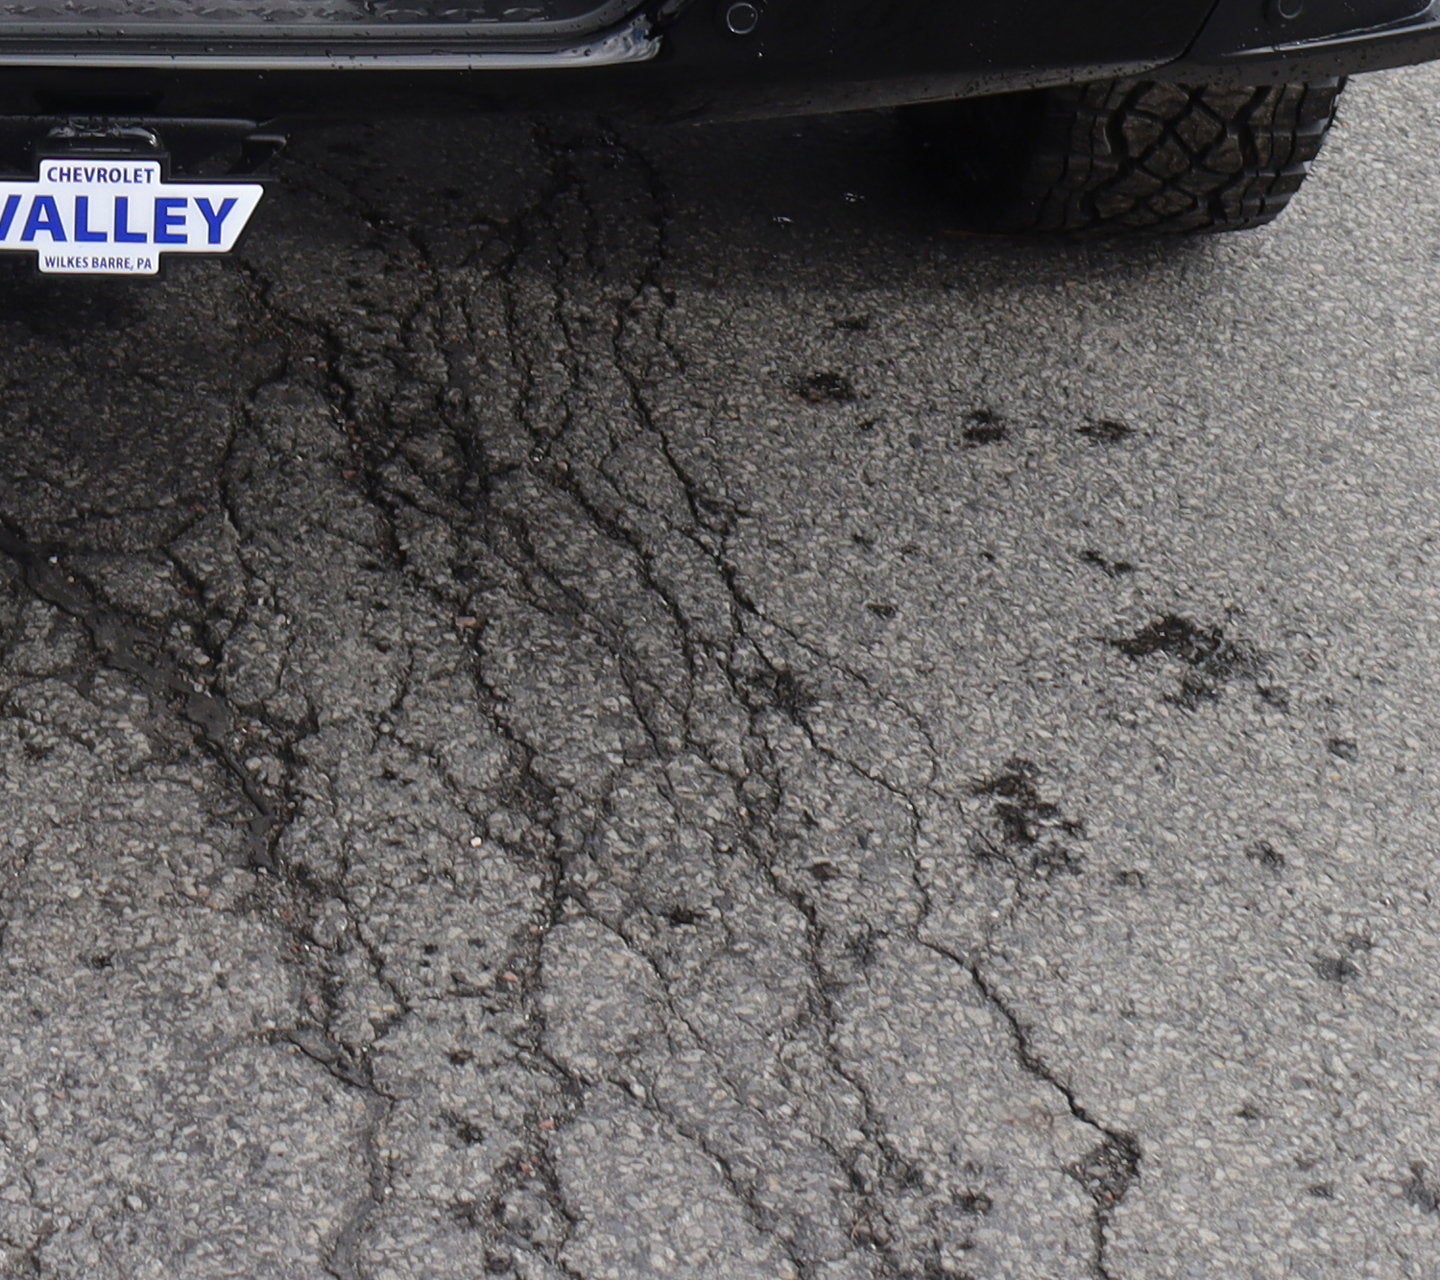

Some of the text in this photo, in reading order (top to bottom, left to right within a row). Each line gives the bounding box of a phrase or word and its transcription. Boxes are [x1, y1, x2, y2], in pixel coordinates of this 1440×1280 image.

[46, 166, 155, 184] CHEVROLET
[44, 256, 153, 272] WILKES BARRE, PA
